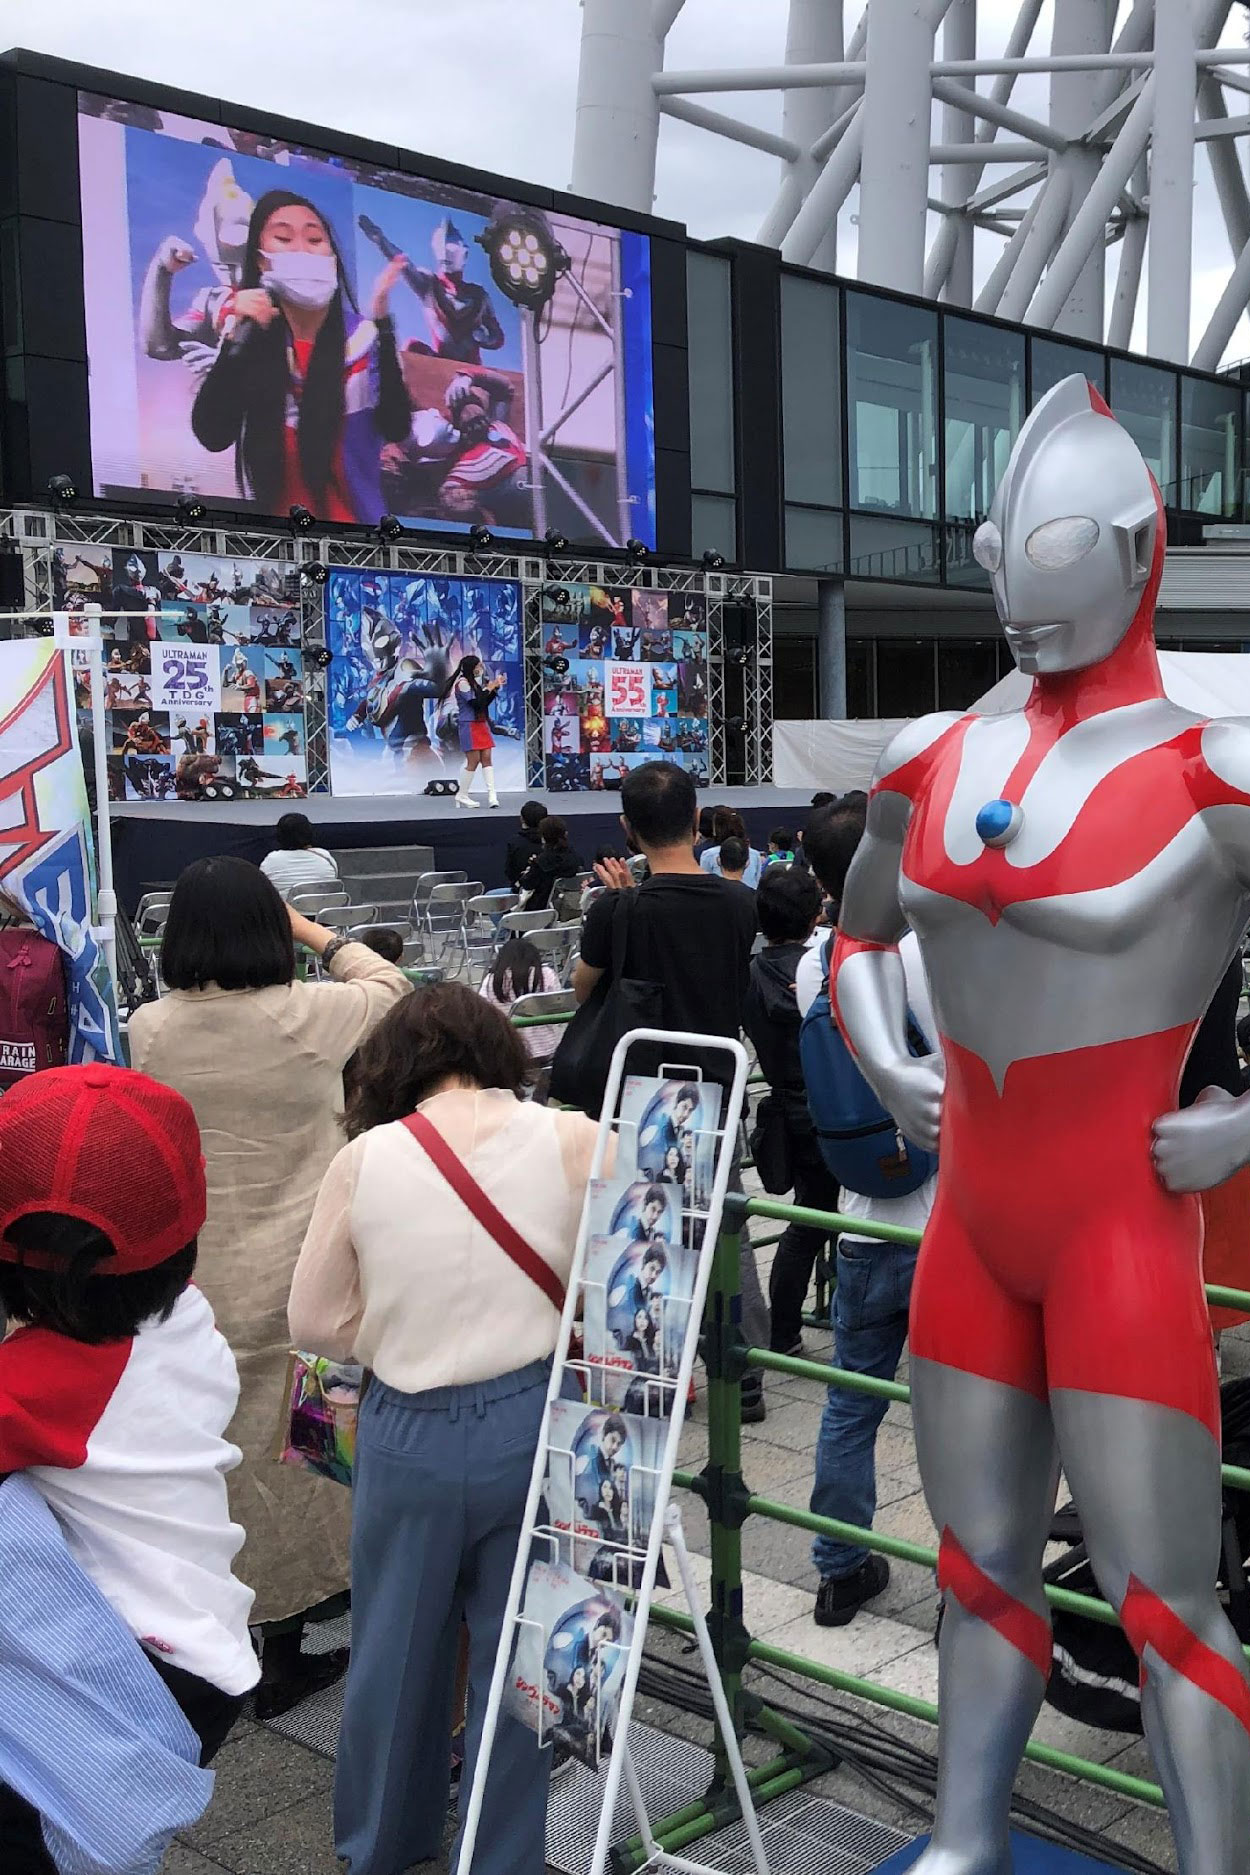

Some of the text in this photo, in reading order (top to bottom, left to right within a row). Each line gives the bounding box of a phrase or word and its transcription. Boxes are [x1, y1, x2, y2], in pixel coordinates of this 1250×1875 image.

[162, 649, 208, 660] ULTRAMAN
[611, 667, 643, 675] ULTRAMAN
[161, 698, 213, 706] Anniversary
